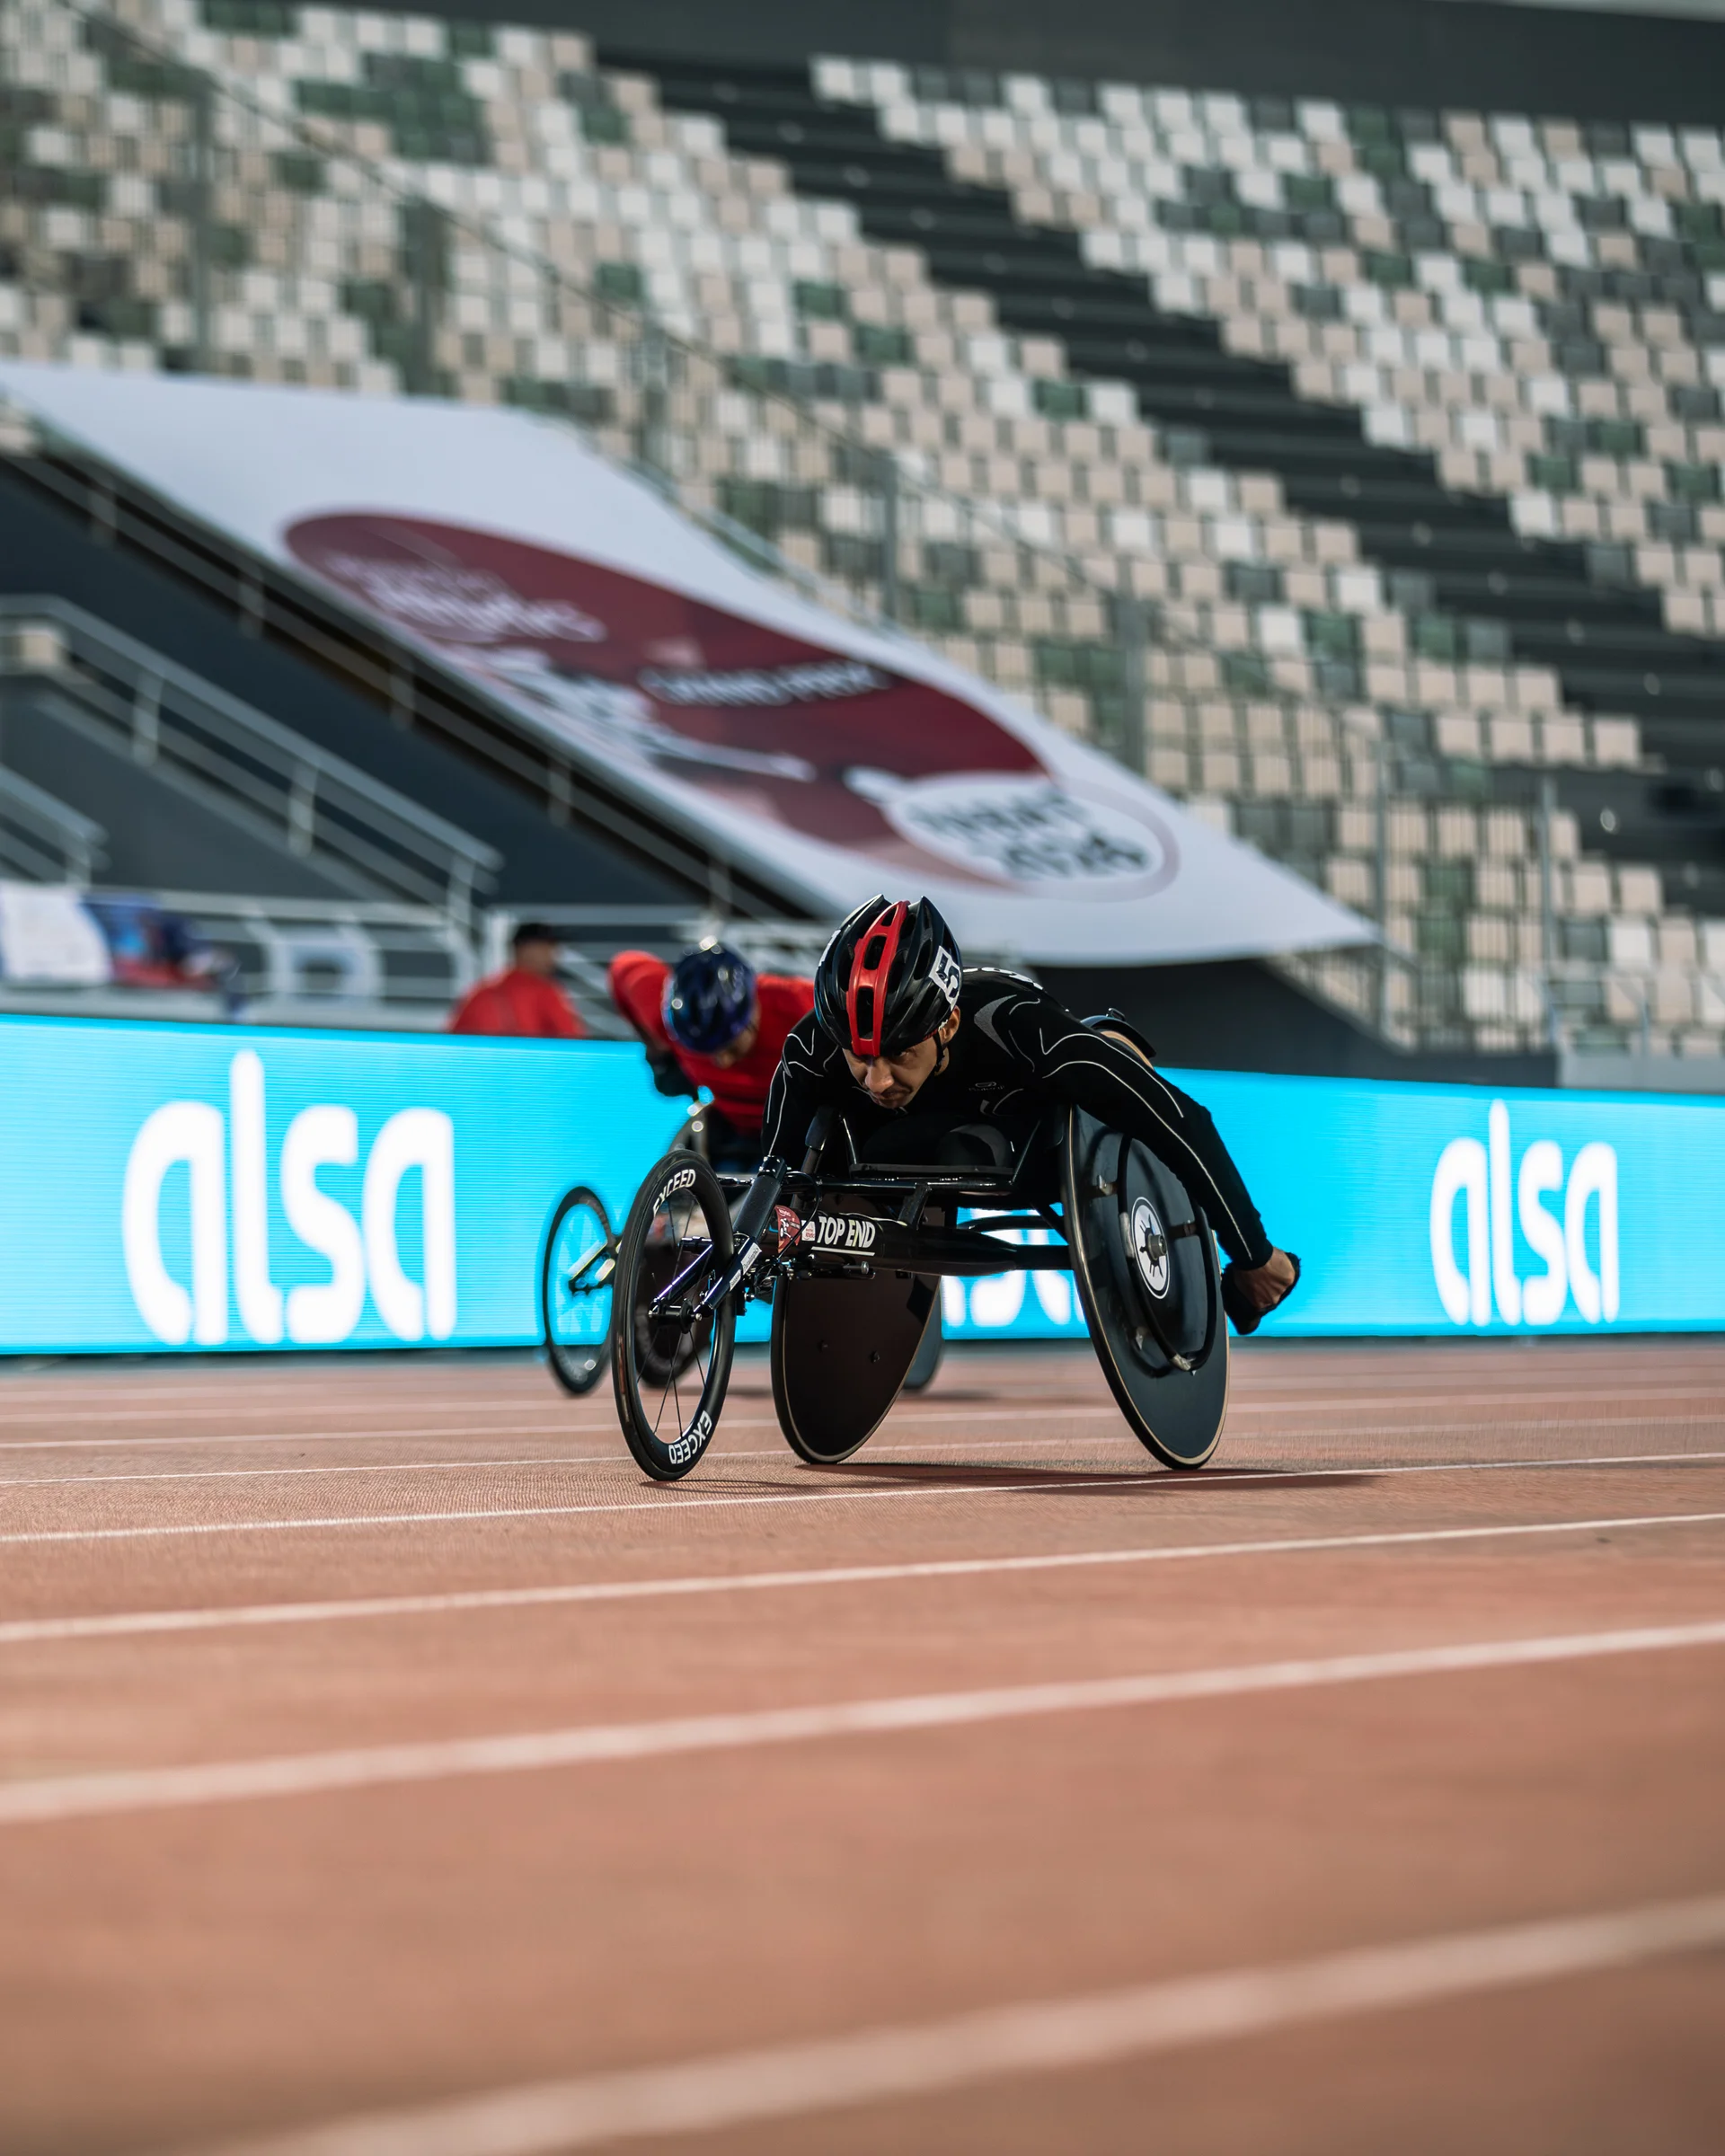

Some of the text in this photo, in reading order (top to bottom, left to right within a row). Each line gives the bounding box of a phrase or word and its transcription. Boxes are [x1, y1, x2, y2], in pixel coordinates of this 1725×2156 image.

[122, 1048, 456, 1344] alsa
[652, 1169, 696, 1217] EXCEED
[1430, 1099, 1619, 1327] alsa
[817, 1215, 876, 1248] TOP END
[668, 1409, 712, 1464] EXCEED
